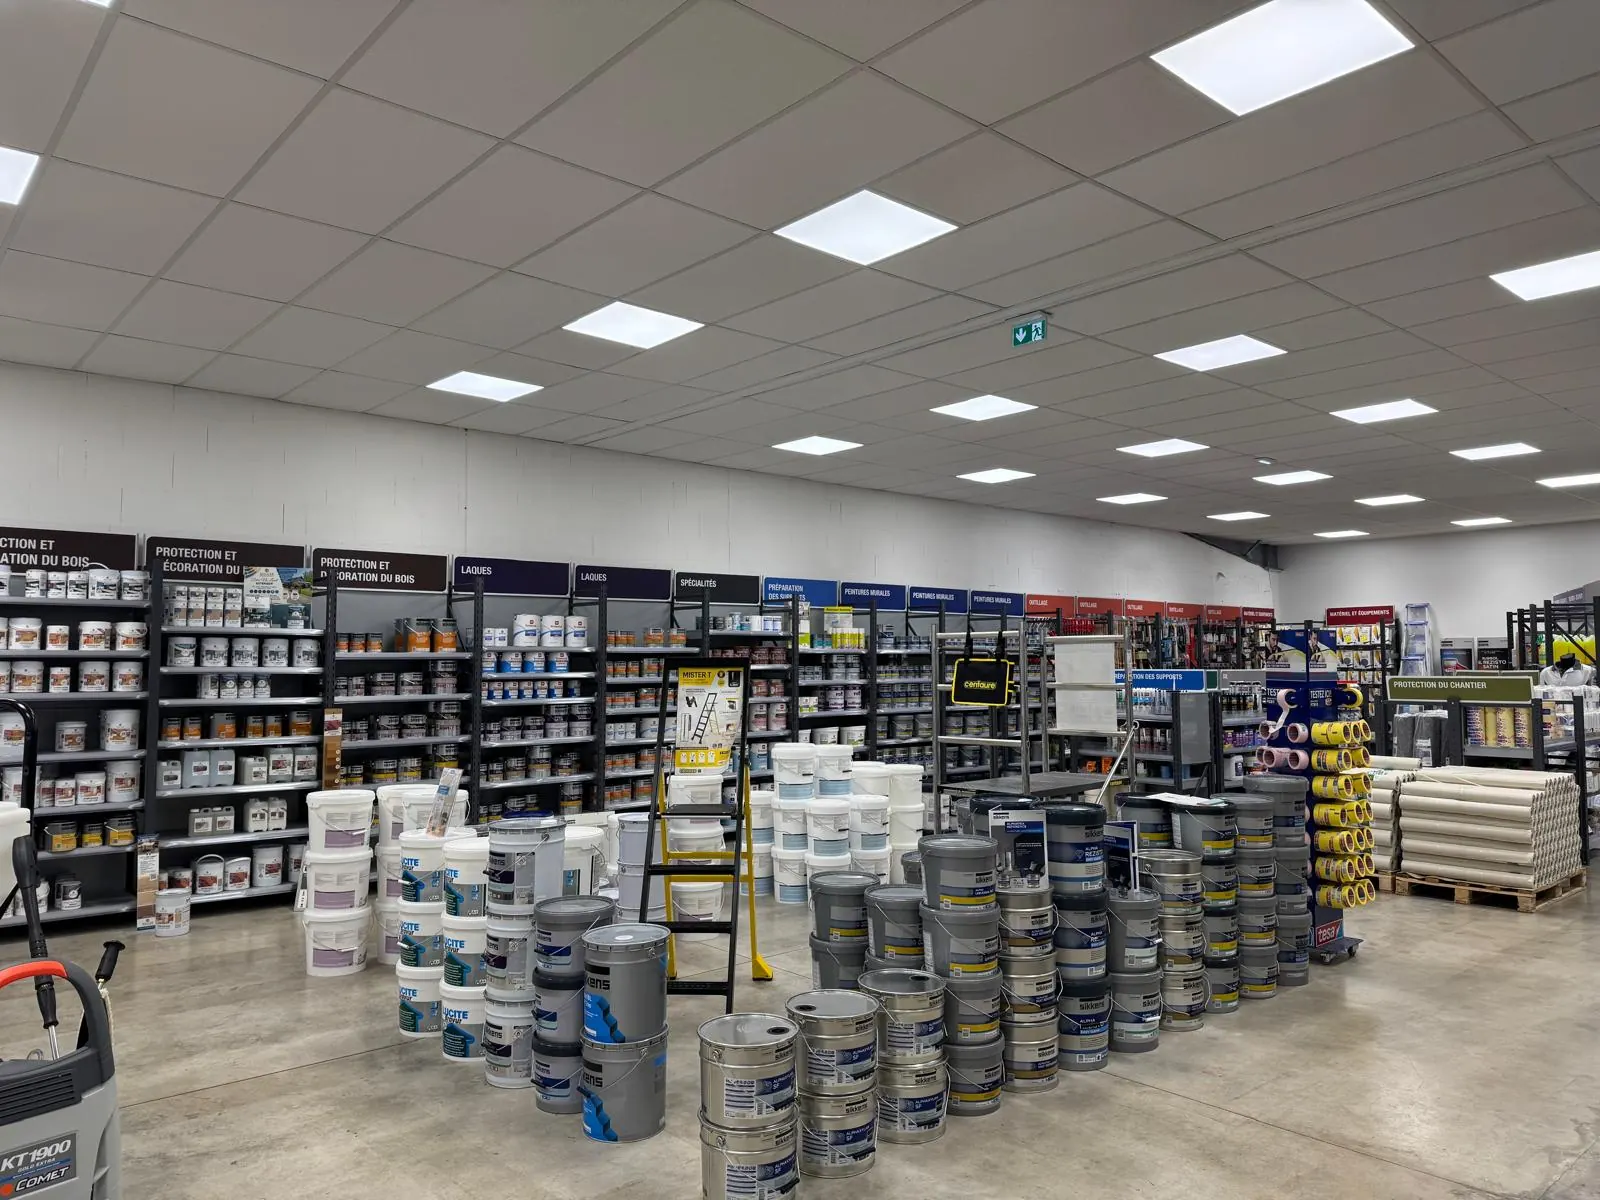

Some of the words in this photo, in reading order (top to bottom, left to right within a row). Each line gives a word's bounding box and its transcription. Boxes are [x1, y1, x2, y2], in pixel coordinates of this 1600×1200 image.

[0, 538, 36, 550] CTION
[40, 540, 55, 551] ET
[156, 546, 222, 560] PROTECTION
[225, 551, 237, 561] ET
[0, 553, 38, 565] ATION
[46, 555, 58, 566] DU
[62, 556, 90, 568] BOIS
[320, 557, 377, 570] PROTECTION
[379, 561, 390, 571] ET
[163, 559, 223, 574] ÉCORATION
[226, 565, 240, 575] DU
[461, 565, 492, 576] LAQUES
[380, 574, 392, 583] DU
[395, 574, 415, 584] BOIS
[581, 572, 607, 582] LAQUES
[680, 578, 717, 588] SPÉCIALITÉS
[844, 588, 870, 596] PEINTURES
[912, 592, 936, 600] PEINTURES
[1393, 681, 1437, 689] PROTECTION
[1450, 681, 1487, 689] CHANTIER
[1267, 688, 1279, 696] TEST
[1318, 926, 1335, 943] tesa
[15, 1166, 70, 1192] COMET
